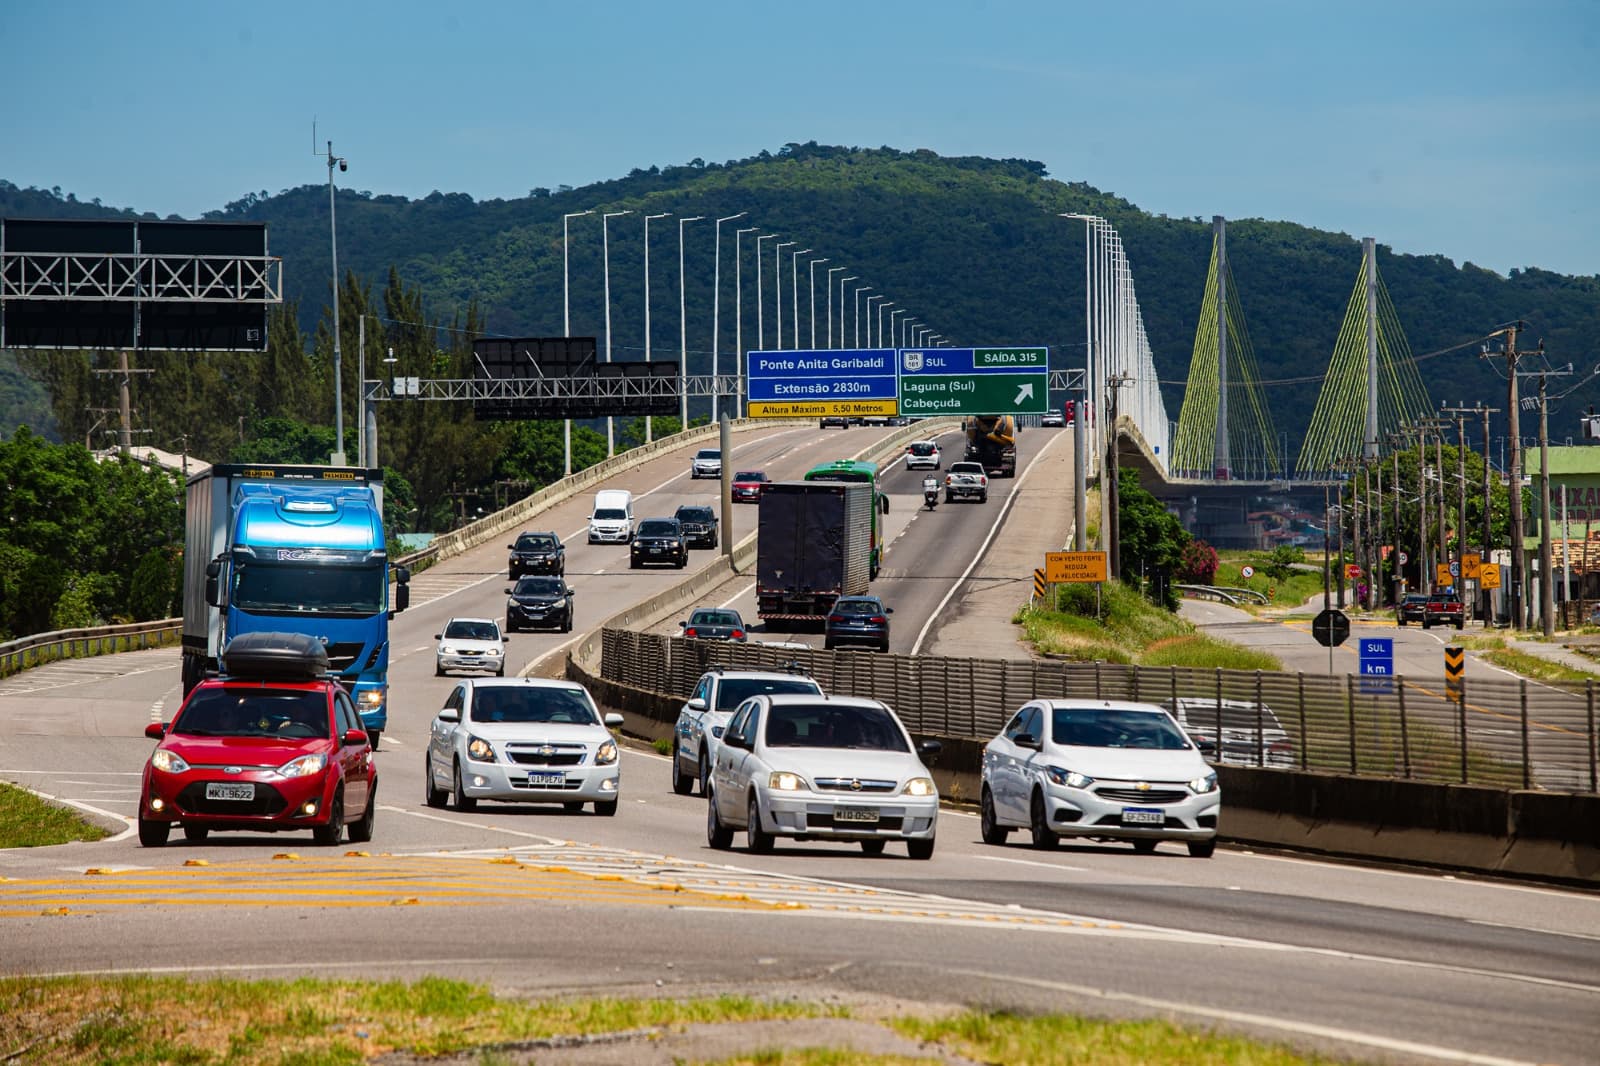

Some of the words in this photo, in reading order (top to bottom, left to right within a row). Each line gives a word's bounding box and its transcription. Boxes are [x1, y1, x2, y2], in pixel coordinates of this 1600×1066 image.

[926, 358, 947, 367] SUL
[984, 352, 1017, 363] SAÍDA
[1020, 353, 1037, 362] 315
[760, 360, 794, 370] Ponte
[797, 359, 828, 369] Anita
[832, 358, 884, 368] Garibaldi
[774, 384, 830, 394] Extensão
[833, 382, 870, 393] 2830m
[904, 382, 946, 394] Laguna
[949, 381, 976, 392] (Sul)
[762, 406, 788, 414] Altura
[854, 404, 884, 412] Metros
[904, 398, 961, 410] Cabeçuda
[1368, 644, 1385, 652] SUL
